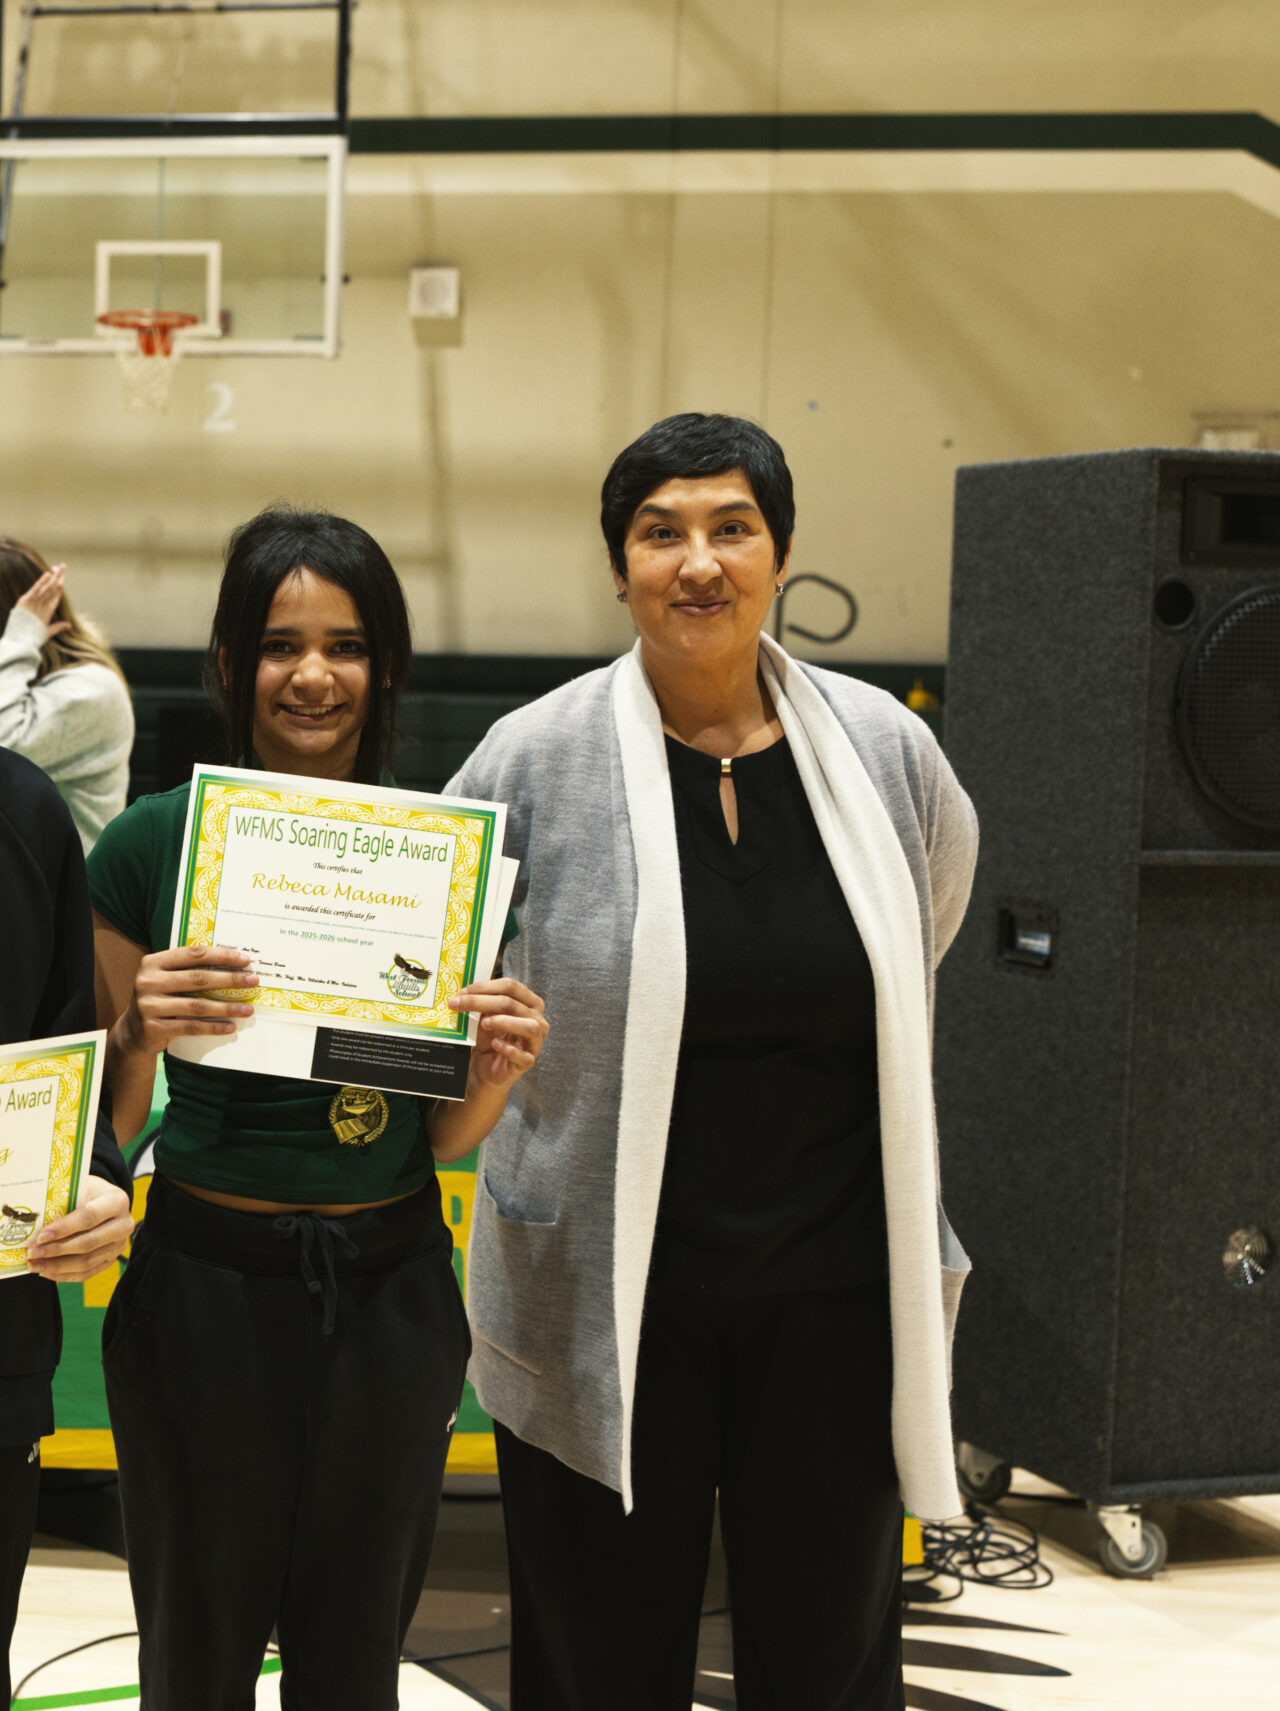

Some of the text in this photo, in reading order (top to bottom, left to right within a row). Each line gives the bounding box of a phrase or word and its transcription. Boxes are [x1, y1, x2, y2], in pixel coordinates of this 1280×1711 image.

[203, 381, 237, 433] 2
[235, 815, 449, 863] WFMS Soaring Eagle Award
[313, 862, 363, 875] This certifies that
[251, 872, 423, 909] Rebeca Masami
[284, 902, 290, 910] is
[291, 904, 319, 913] awarded
[319, 906, 332, 915] this
[333, 909, 365, 921] certificate
[364, 913, 376, 921] for
[287, 929, 300, 937] the
[300, 929, 336, 942] 2025-2026
[336, 935, 359, 944] school
[359, 939, 374, 947] year
[5, 1084, 53, 1113] Award
